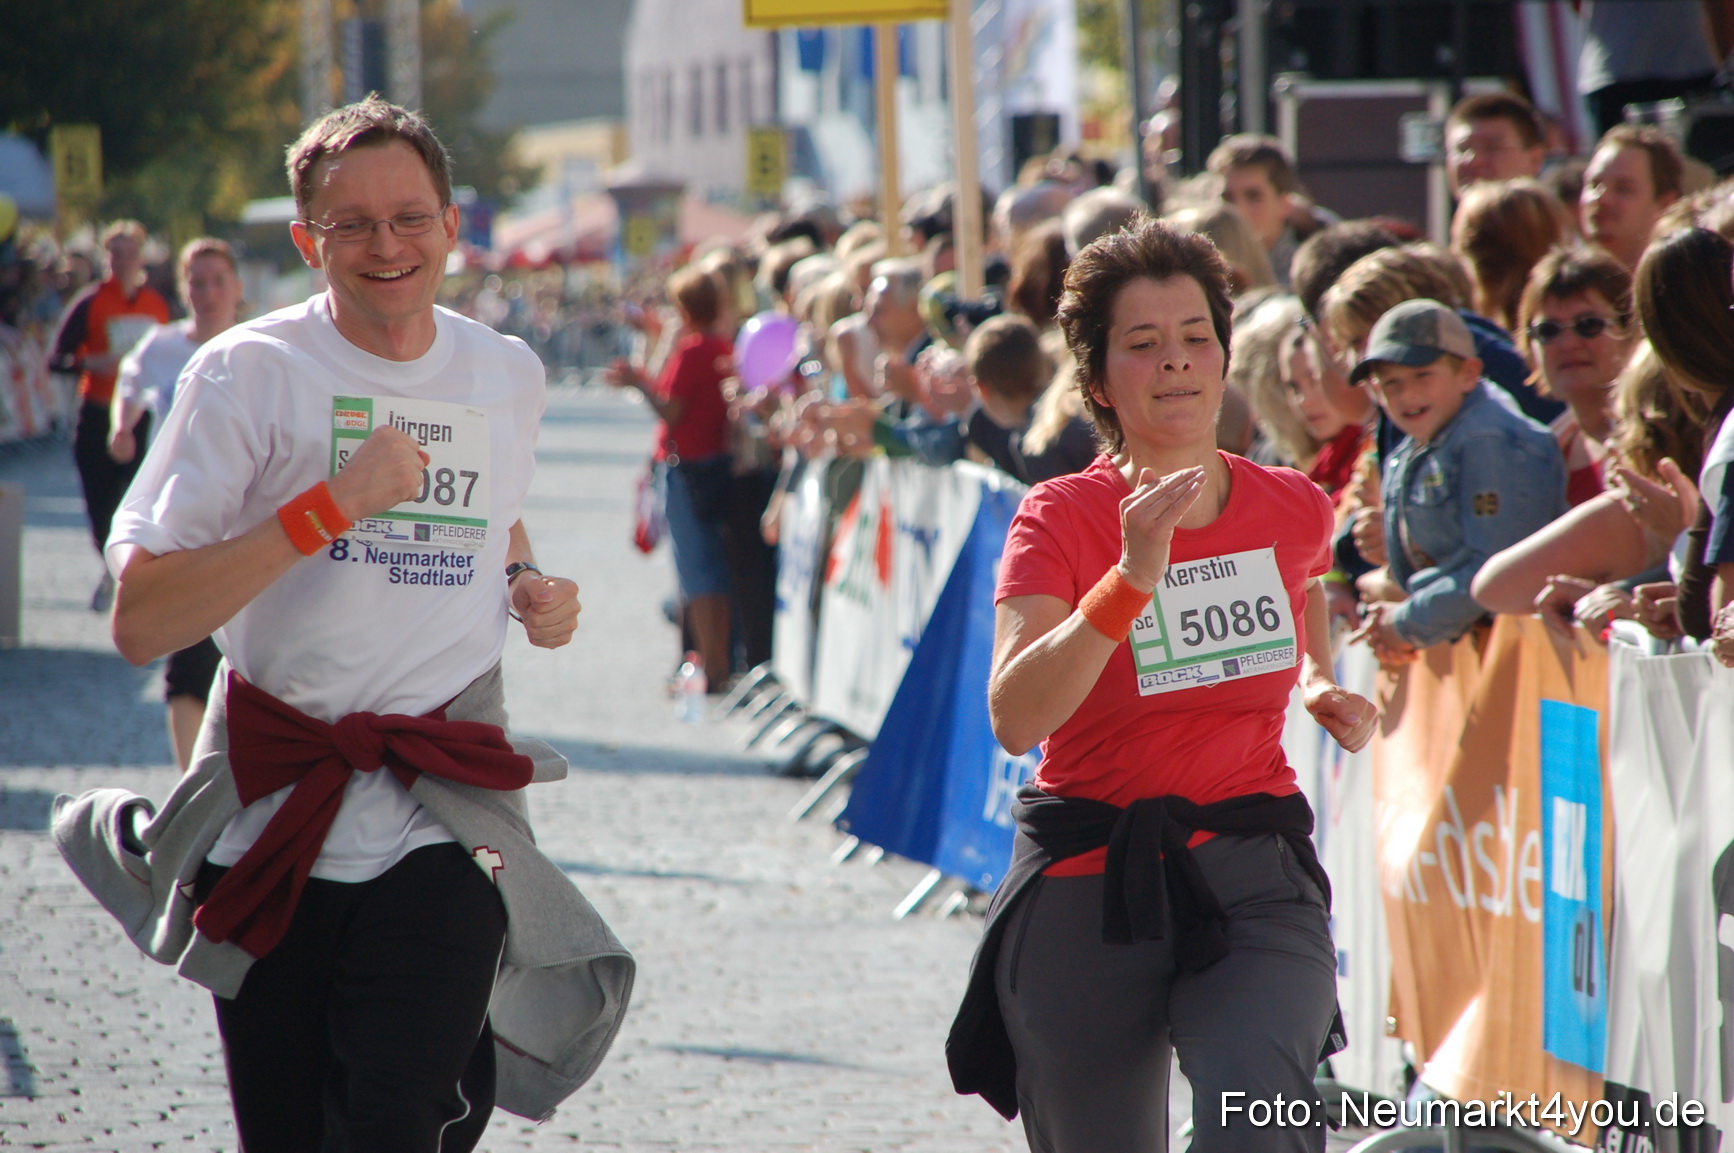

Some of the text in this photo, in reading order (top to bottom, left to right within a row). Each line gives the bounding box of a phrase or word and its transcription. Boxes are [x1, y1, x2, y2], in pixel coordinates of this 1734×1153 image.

[432, 524, 487, 541] PFLEIDERER
[329, 538, 474, 568] 8. Neumarkter
[388, 567, 475, 586] Stadtlauf
[1164, 556, 1238, 588] Kerstin
[1180, 595, 1280, 647] 5086
[1240, 647, 1294, 667] PFLEIDERER
[1140, 664, 1203, 689] ROCK
